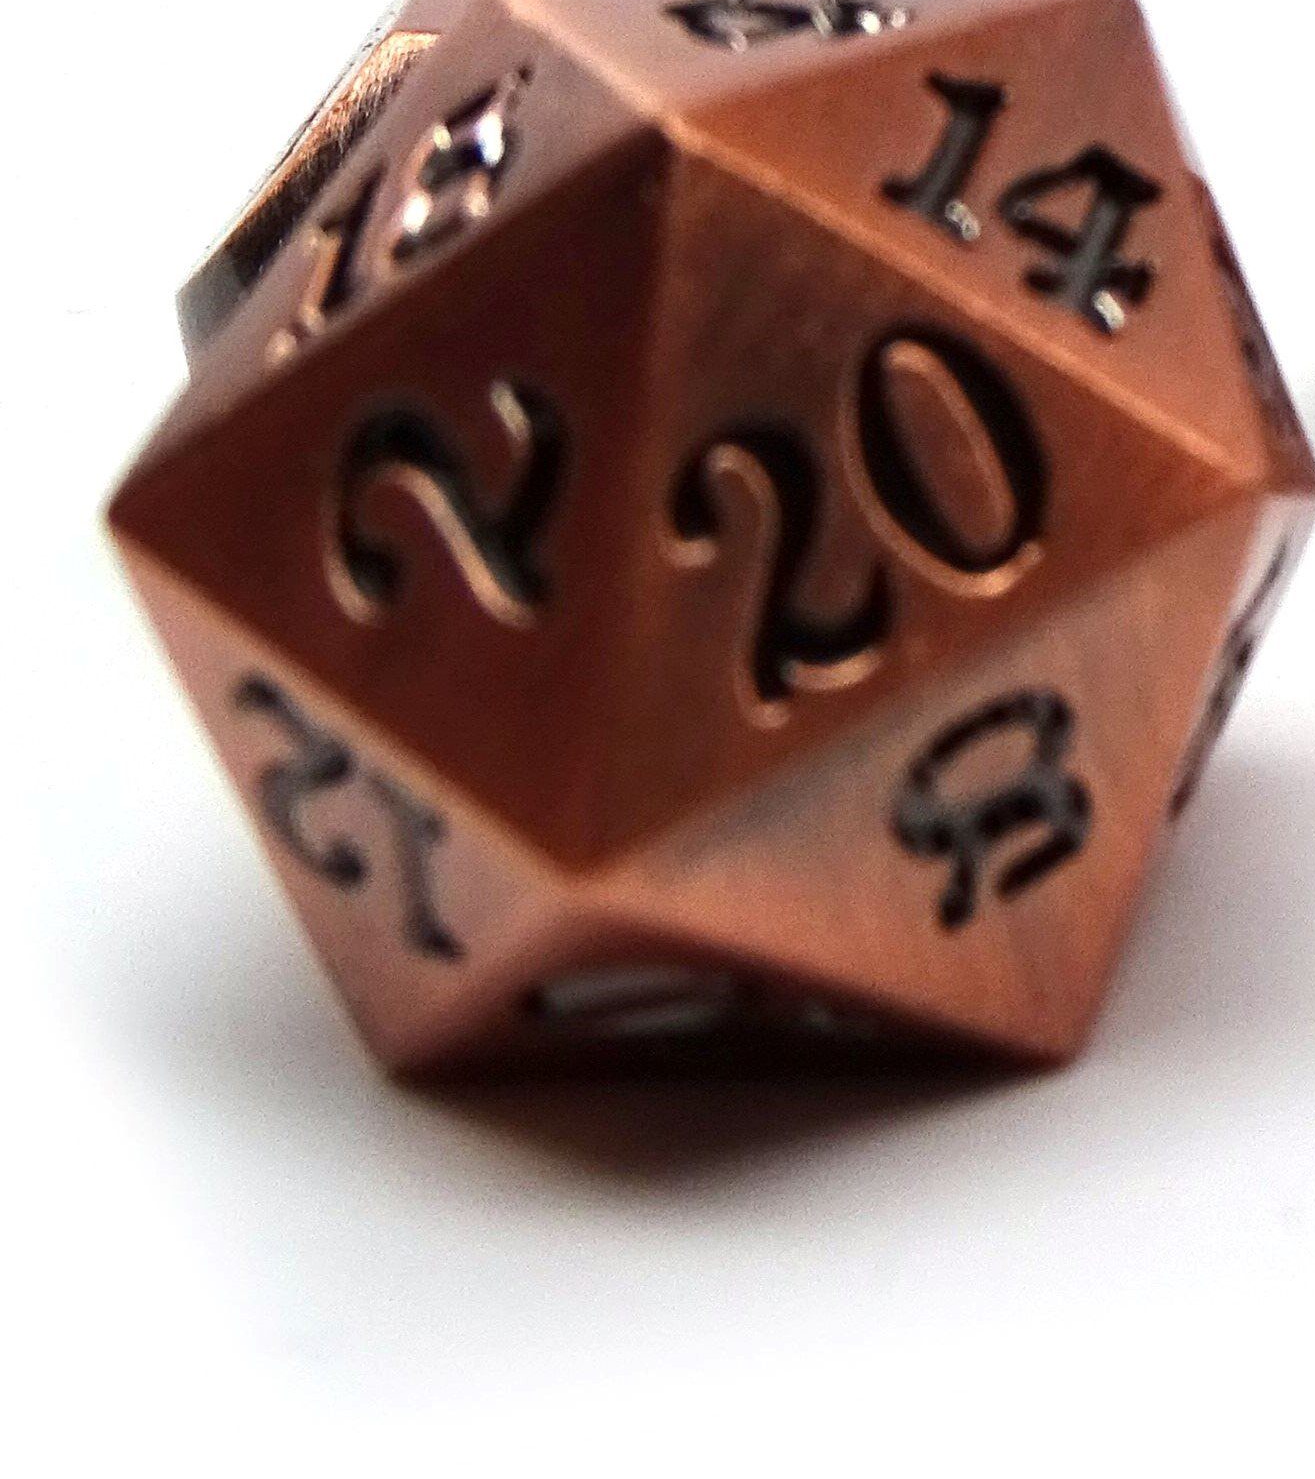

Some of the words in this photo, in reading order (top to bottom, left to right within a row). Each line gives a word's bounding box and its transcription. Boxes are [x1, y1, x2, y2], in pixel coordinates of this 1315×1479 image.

[880, 70, 1165, 336] 14
[318, 376, 570, 627] 2
[658, 321, 1052, 729] 20
[888, 687, 1095, 935] 8
